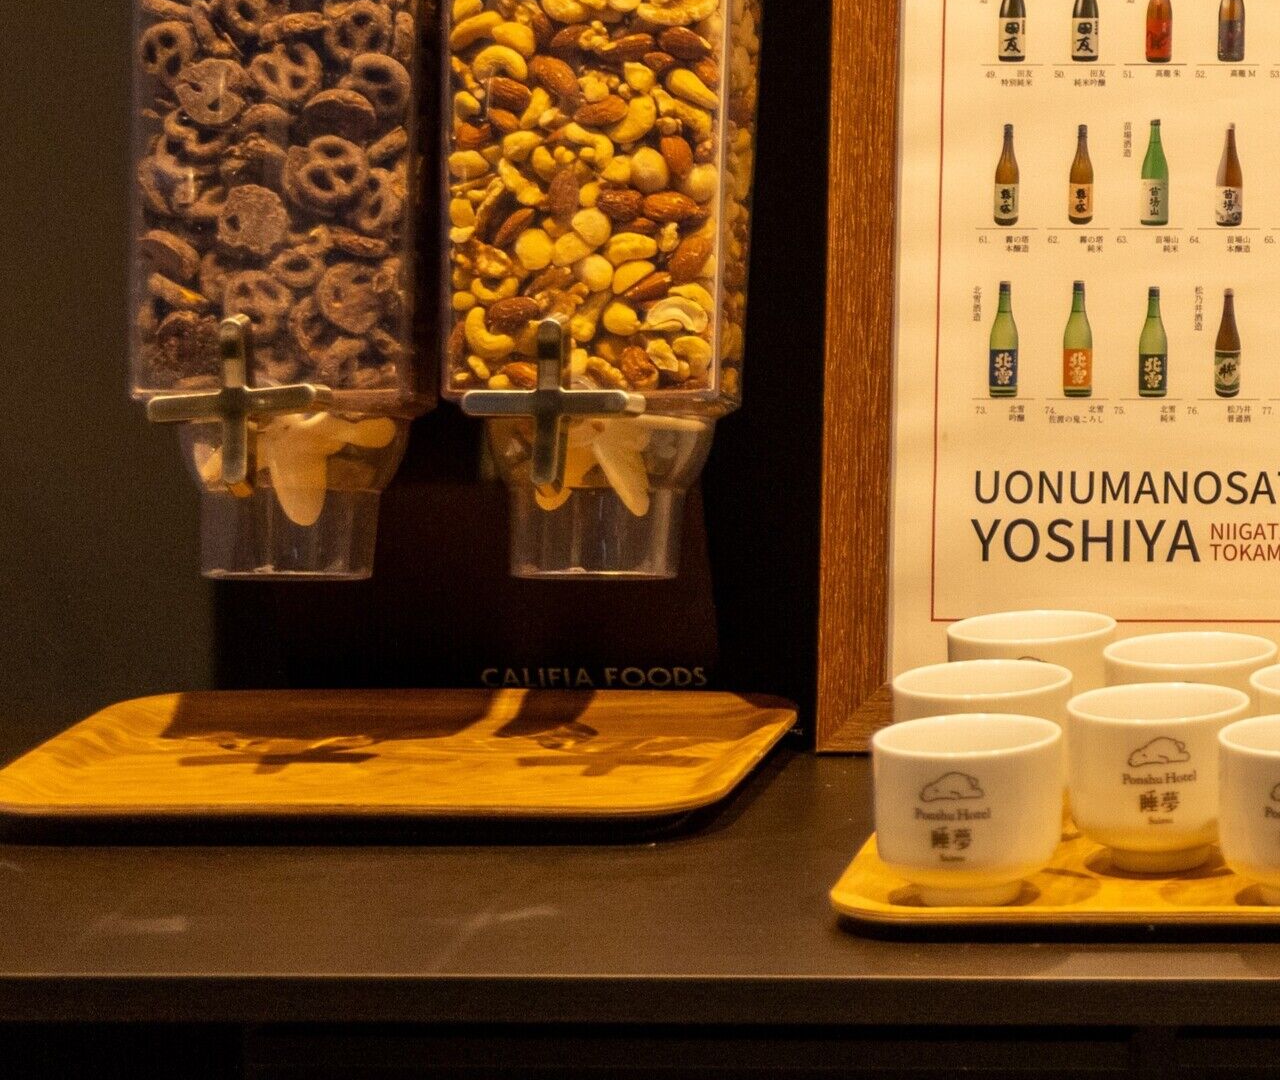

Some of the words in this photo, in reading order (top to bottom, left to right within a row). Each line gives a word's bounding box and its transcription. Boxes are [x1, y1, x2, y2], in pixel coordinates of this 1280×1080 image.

[1000, 76, 1033, 88] 特別純米
[974, 405, 989, 416] 73.
[1008, 404, 1026, 414] 北雪
[1044, 405, 1059, 417] 74.
[1087, 404, 1105, 414] 北雪
[1008, 413, 1026, 423] 吟醸
[971, 518, 1200, 563] YOSHIYA
[481, 668, 593, 688] CALIFIA
[604, 667, 707, 688] FOODS
[1123, 774, 1160, 786] Ponshu
[1165, 772, 1197, 784] Hotel
[914, 808, 954, 821] Ponshu
[957, 807, 991, 820] Hotel
